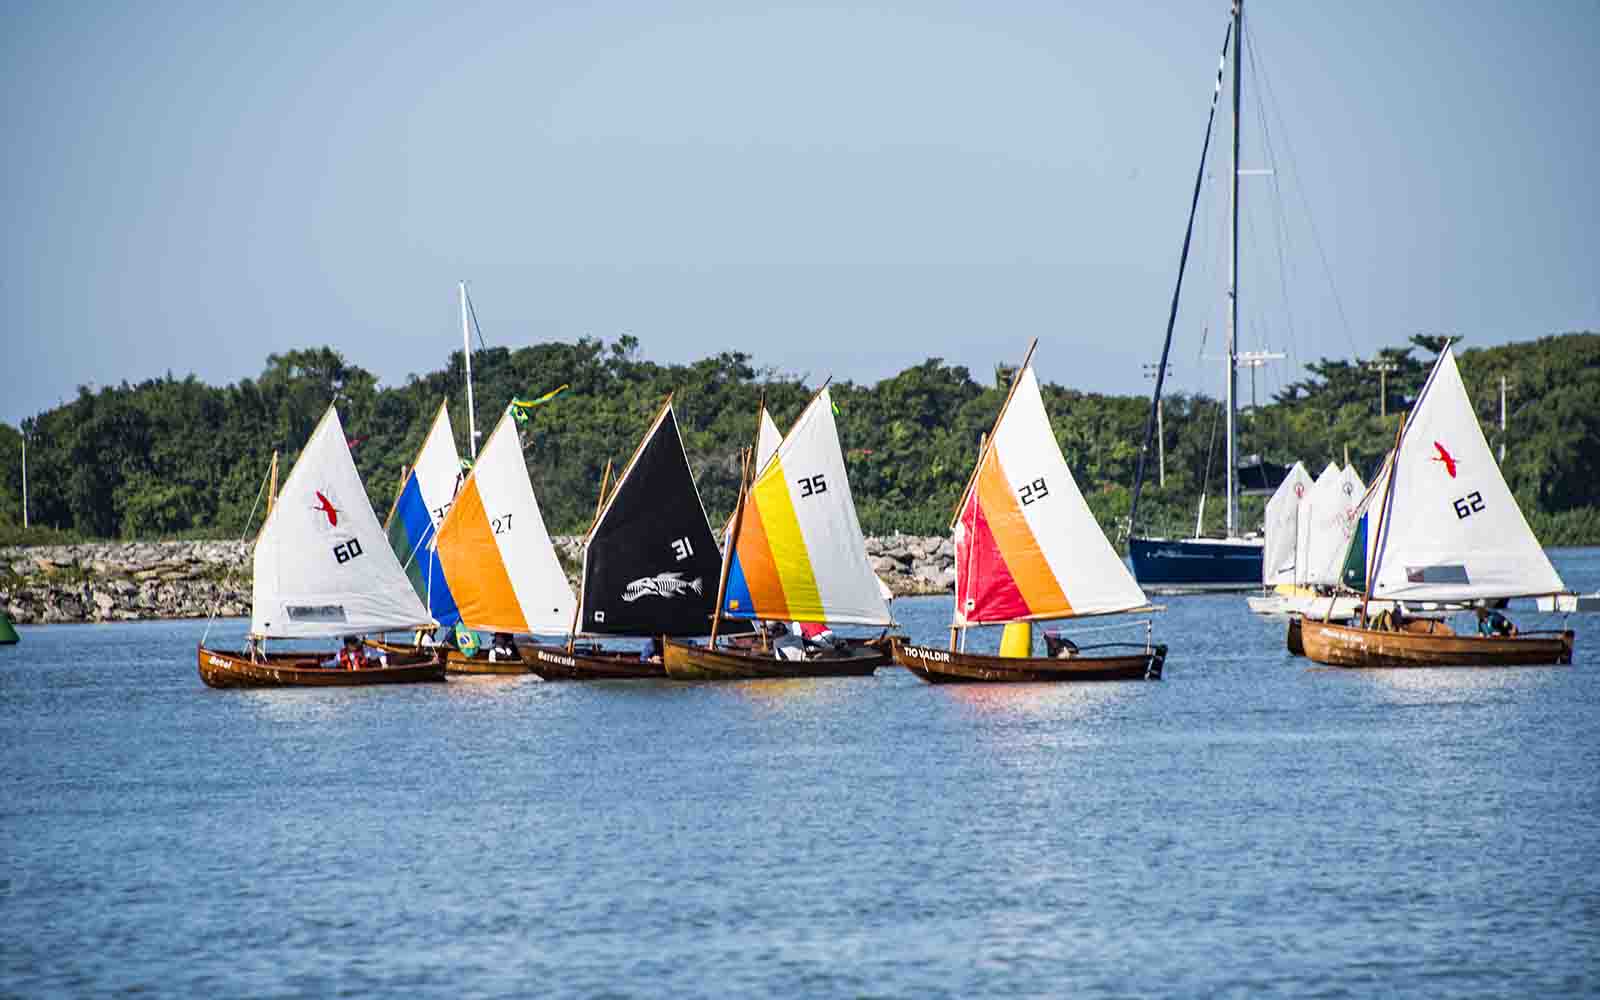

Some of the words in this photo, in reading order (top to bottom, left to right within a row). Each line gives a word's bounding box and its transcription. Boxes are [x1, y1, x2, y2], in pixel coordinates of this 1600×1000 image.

[797, 473, 827, 498] 35
[1018, 477, 1048, 506] 29
[1453, 490, 1485, 519] 62
[492, 513, 512, 534] 27
[333, 538, 363, 564] 60
[671, 536, 693, 560] 31
[904, 646, 918, 658] TIO
[919, 648, 950, 663] VALDIR
